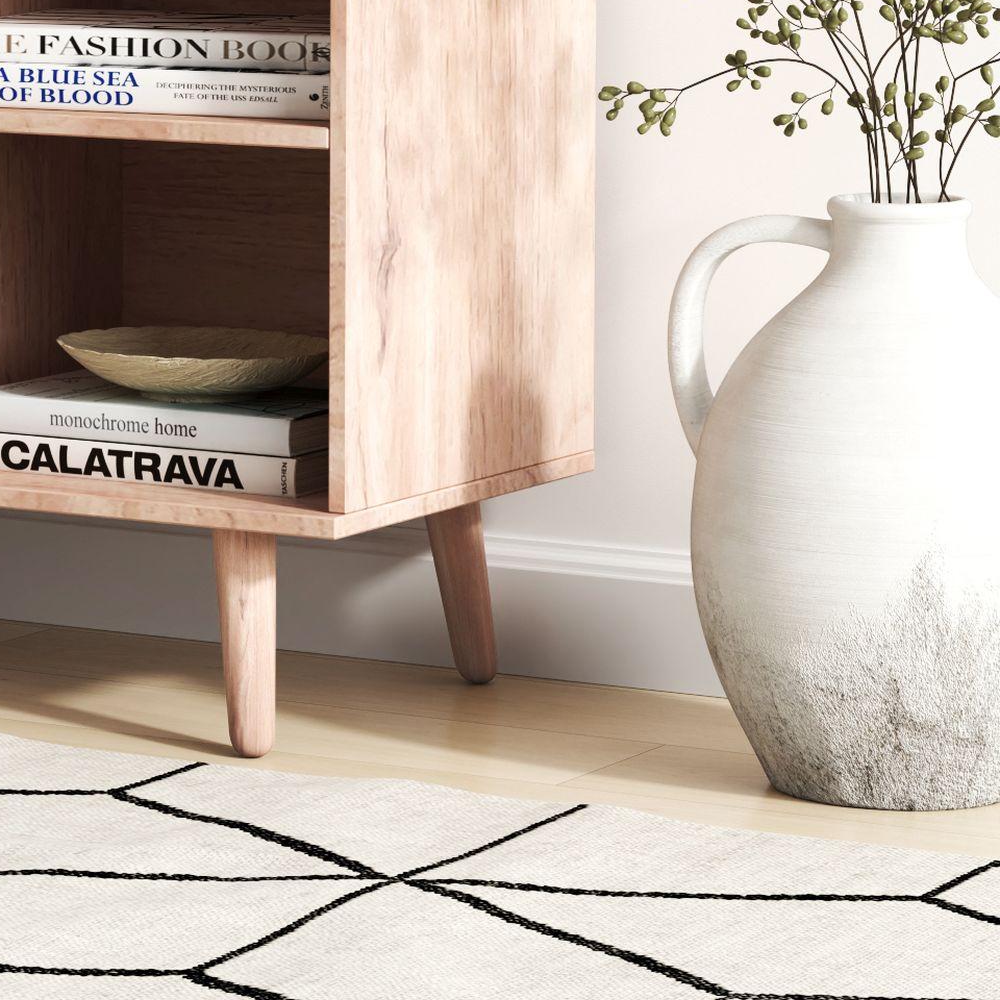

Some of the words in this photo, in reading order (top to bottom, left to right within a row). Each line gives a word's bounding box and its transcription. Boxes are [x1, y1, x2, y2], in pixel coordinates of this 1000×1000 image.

[38, 34, 211, 60] FASHION
[18, 68, 87, 86] BLUE
[92, 70, 140, 88] SEA
[156, 81, 218, 92] DECIPHERING
[218, 83, 238, 92] THE
[239, 84, 297, 94] MYSTERIOUS
[39, 87, 134, 107] BLOOD
[173, 92, 195, 101] FATE
[197, 93, 209, 101] OF
[210, 93, 230, 102] THE
[231, 94, 247, 102] USS
[49, 411, 150, 435] monochrome
[154, 416, 198, 439] home
[0, 439, 245, 491] CALATRAVA
